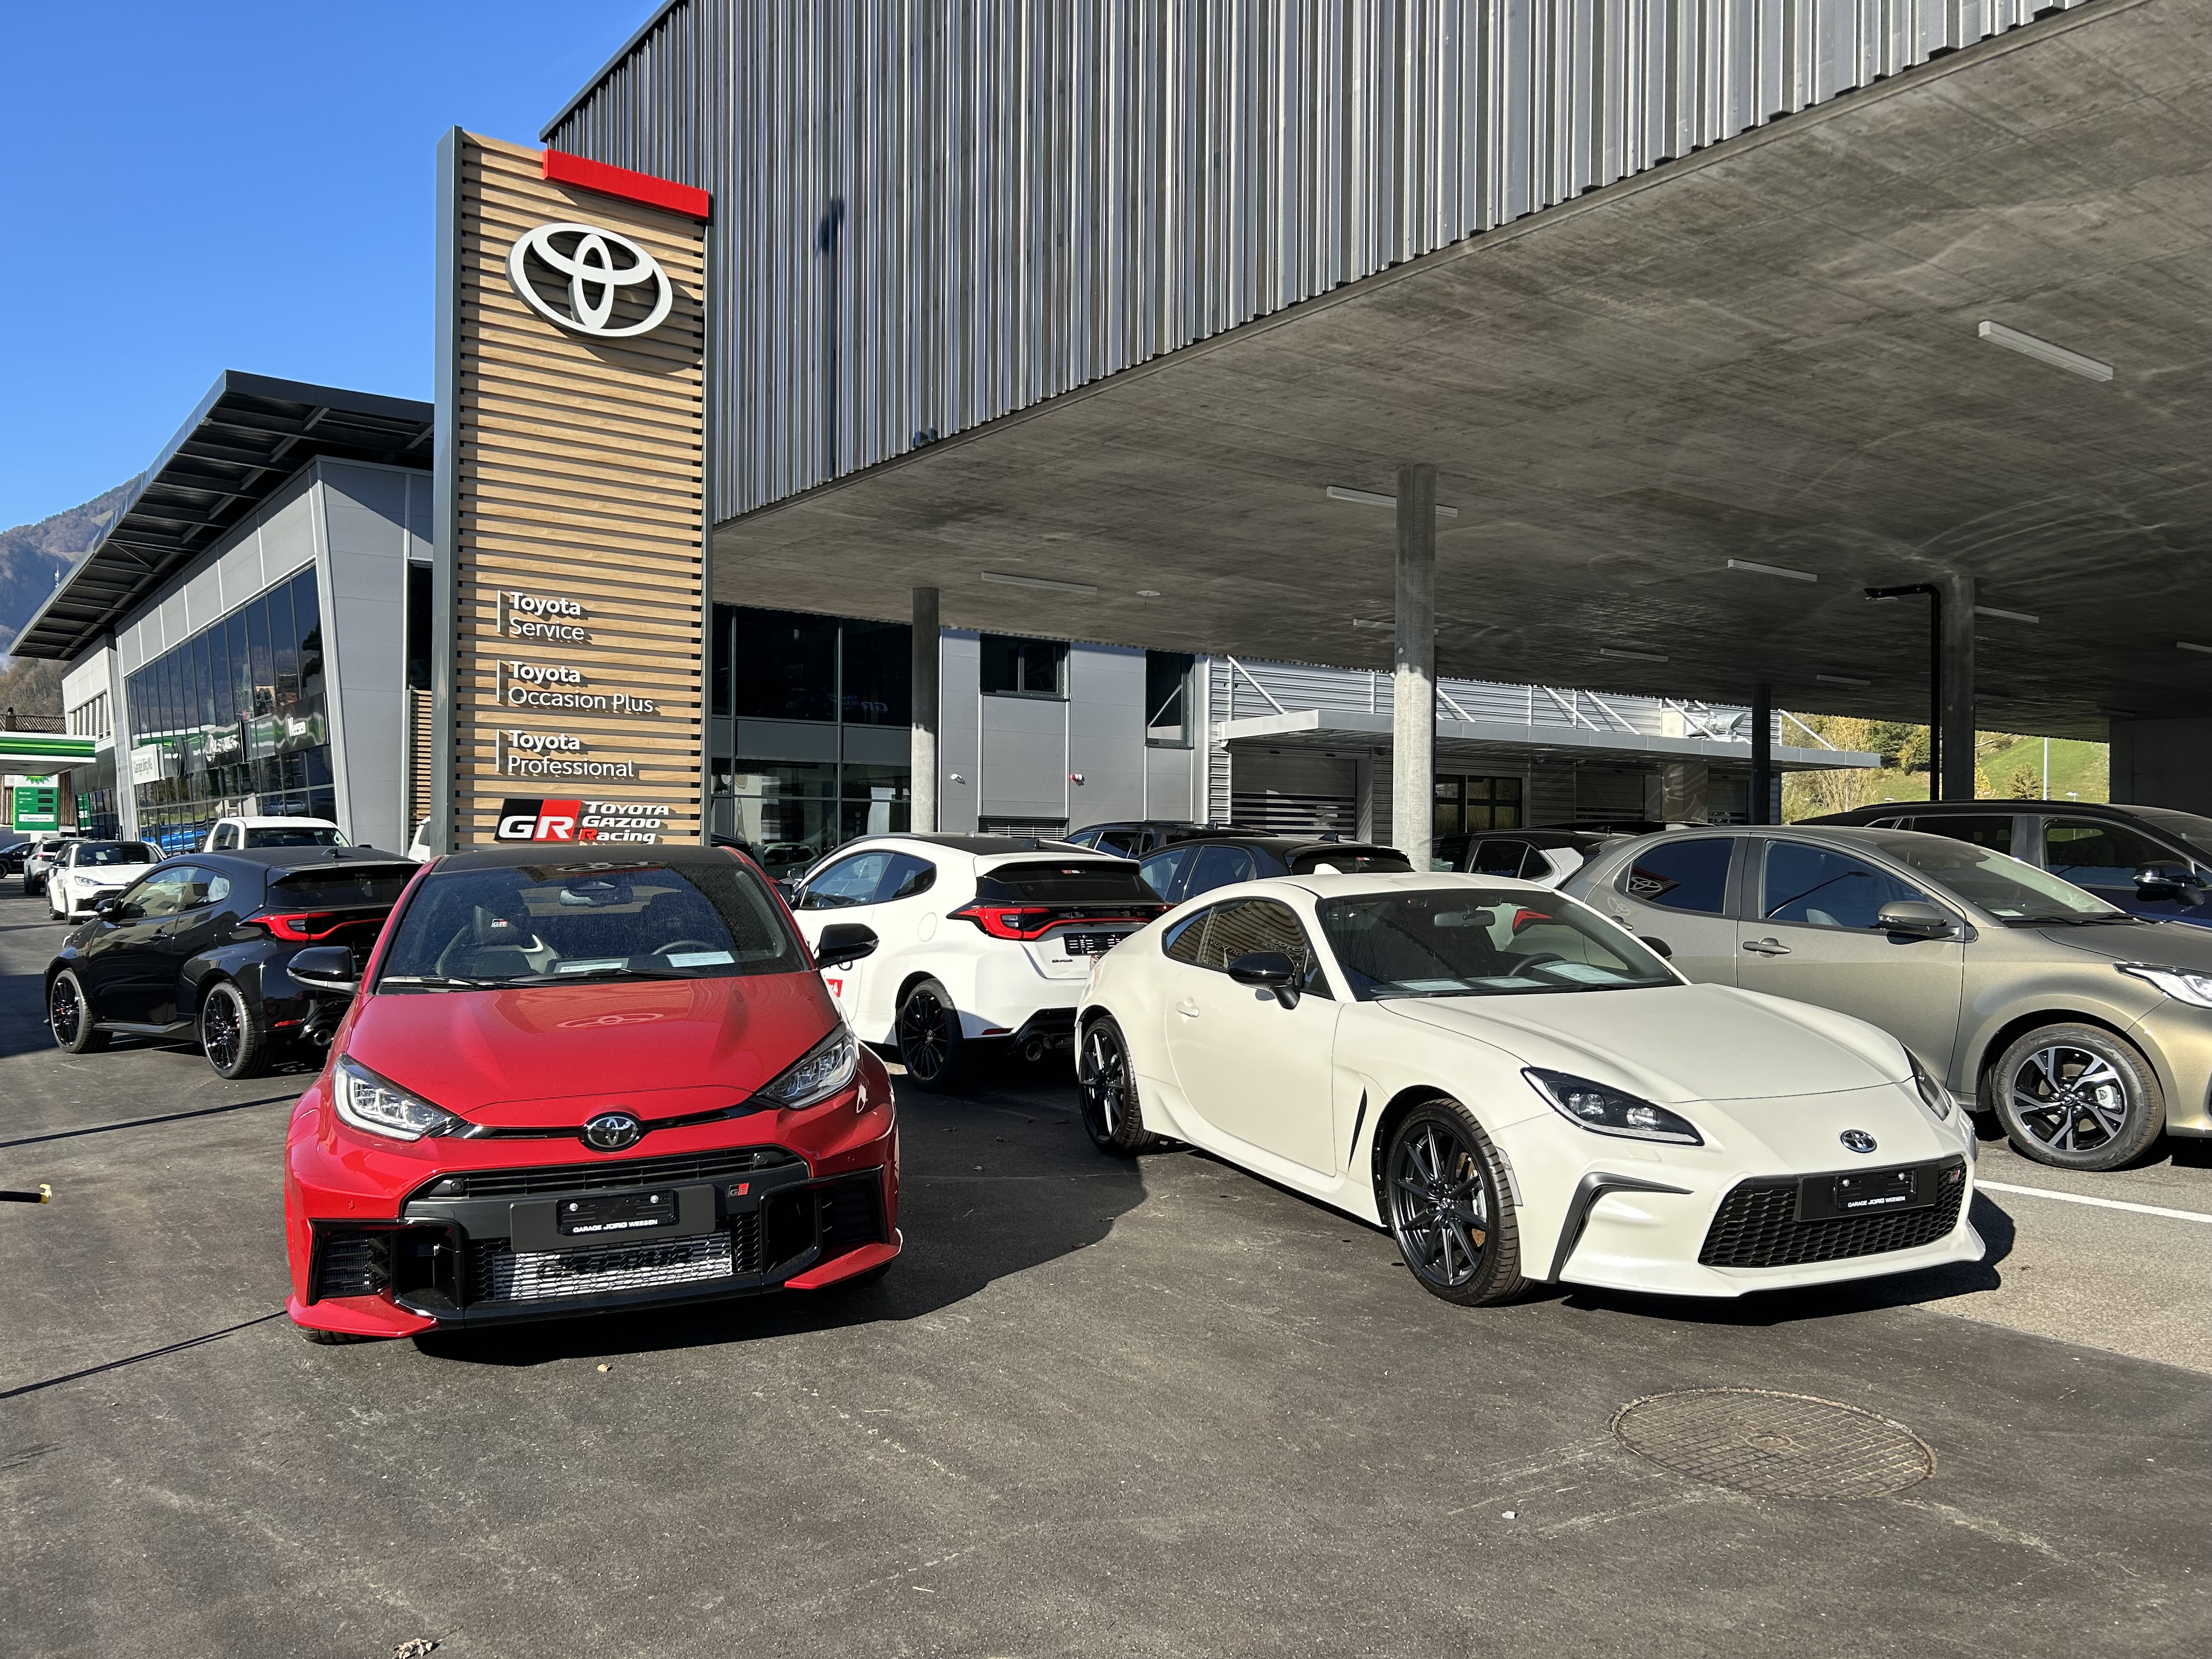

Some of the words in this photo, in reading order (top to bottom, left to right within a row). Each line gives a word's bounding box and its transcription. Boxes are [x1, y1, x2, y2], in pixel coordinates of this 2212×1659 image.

[510, 591, 581, 616] Toyota
[509, 617, 585, 641] Service
[510, 661, 581, 684] Toyota
[509, 686, 606, 709] Occasion
[613, 693, 653, 713] Plus
[509, 730, 580, 752] Toyota
[509, 755, 634, 777] Professional
[585, 802, 669, 815] TOYOTA
[498, 815, 574, 839] GR
[582, 816, 661, 828] GAZOO
[578, 829, 656, 845] Racing
[573, 1224, 602, 1233] GARAGE
[628, 1219, 658, 1227] WEESEN
